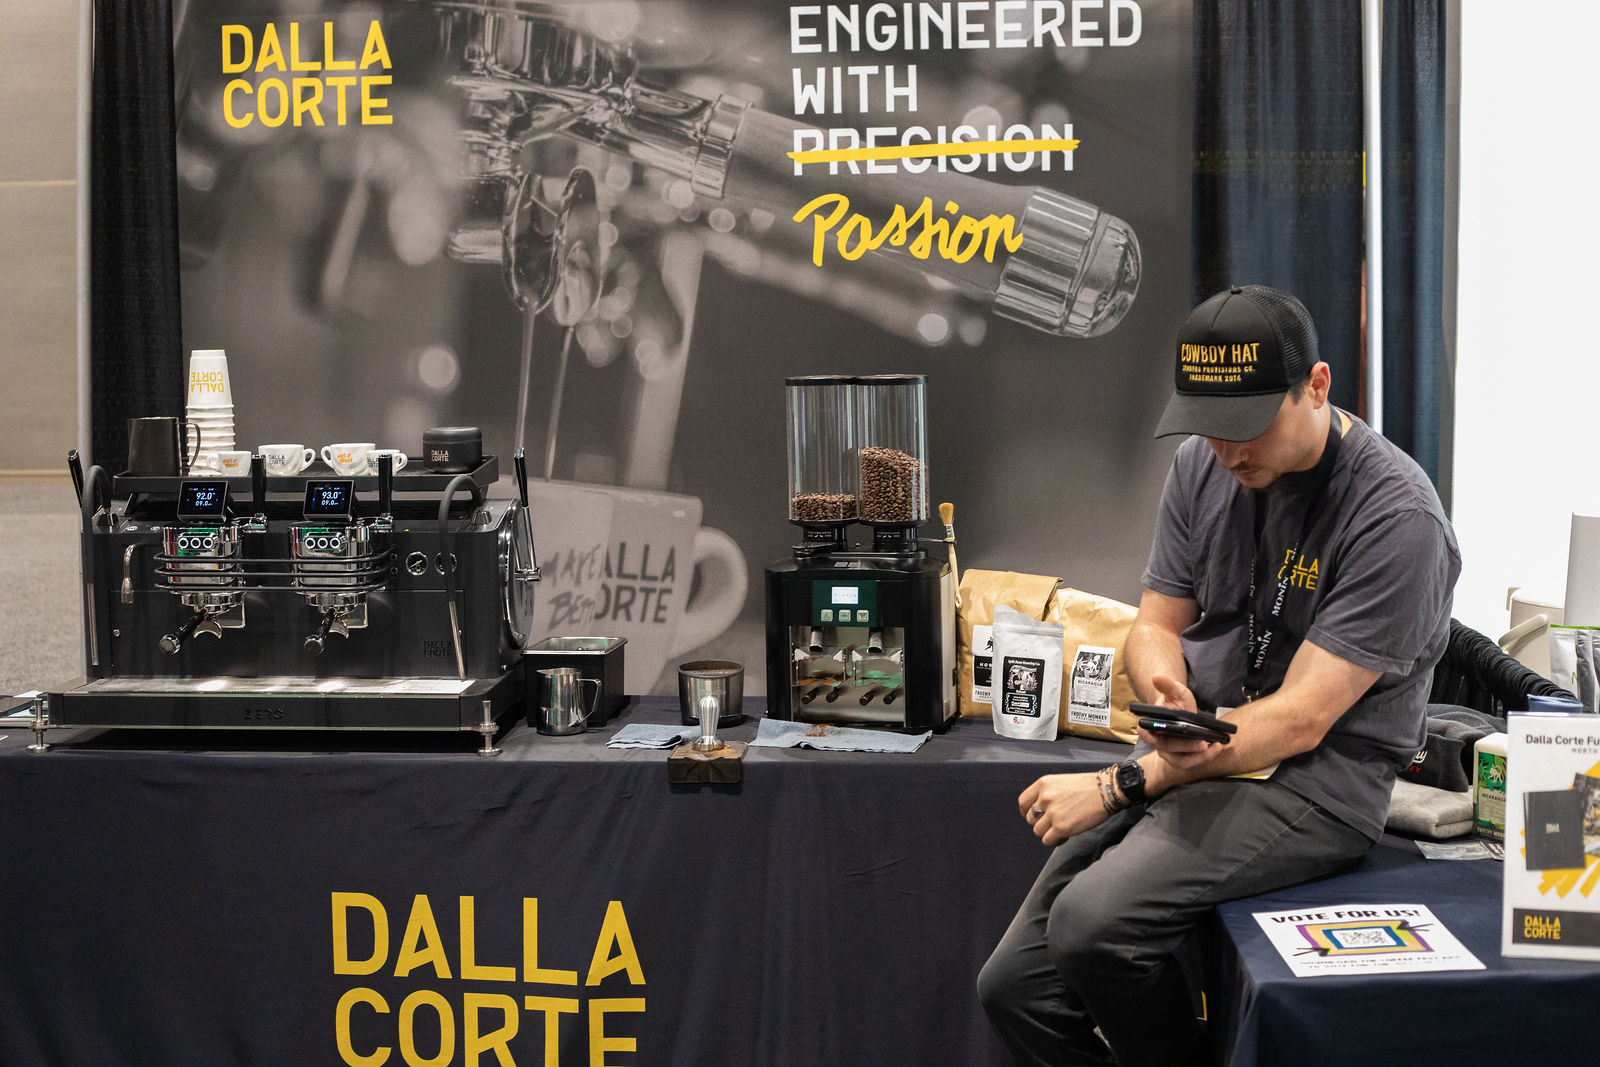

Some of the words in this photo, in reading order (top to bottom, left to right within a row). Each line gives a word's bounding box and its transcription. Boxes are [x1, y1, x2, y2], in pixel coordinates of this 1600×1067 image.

[790, 0, 1142, 53] ENGINEERED
[221, 20, 393, 74] DALLA
[223, 75, 394, 129] CORTE
[792, 65, 918, 115] WITH
[793, 124, 1074, 176] PRECISION
[793, 193, 1024, 267] Passion
[1181, 343, 1227, 363] COWBOY
[1232, 343, 1260, 363] HAT
[190, 382, 225, 393] DALLA
[191, 371, 224, 382] CORTE
[1189, 374, 1223, 382] TRADEMARK
[594, 583, 674, 624] ORTE
[1271, 576, 1289, 616] MONIN
[1254, 630, 1273, 669] MONIN
[1525, 734, 1552, 745] Dalla
[1555, 735, 1584, 745] Corte
[1270, 912, 1330, 923] VOTE
[1334, 910, 1381, 919] FOR
[1386, 909, 1421, 918] US!
[1523, 927, 1562, 939] CORTE
[1524, 915, 1561, 928] DALLA
[331, 891, 646, 986] DALLA
[335, 987, 646, 1067] CORTE
